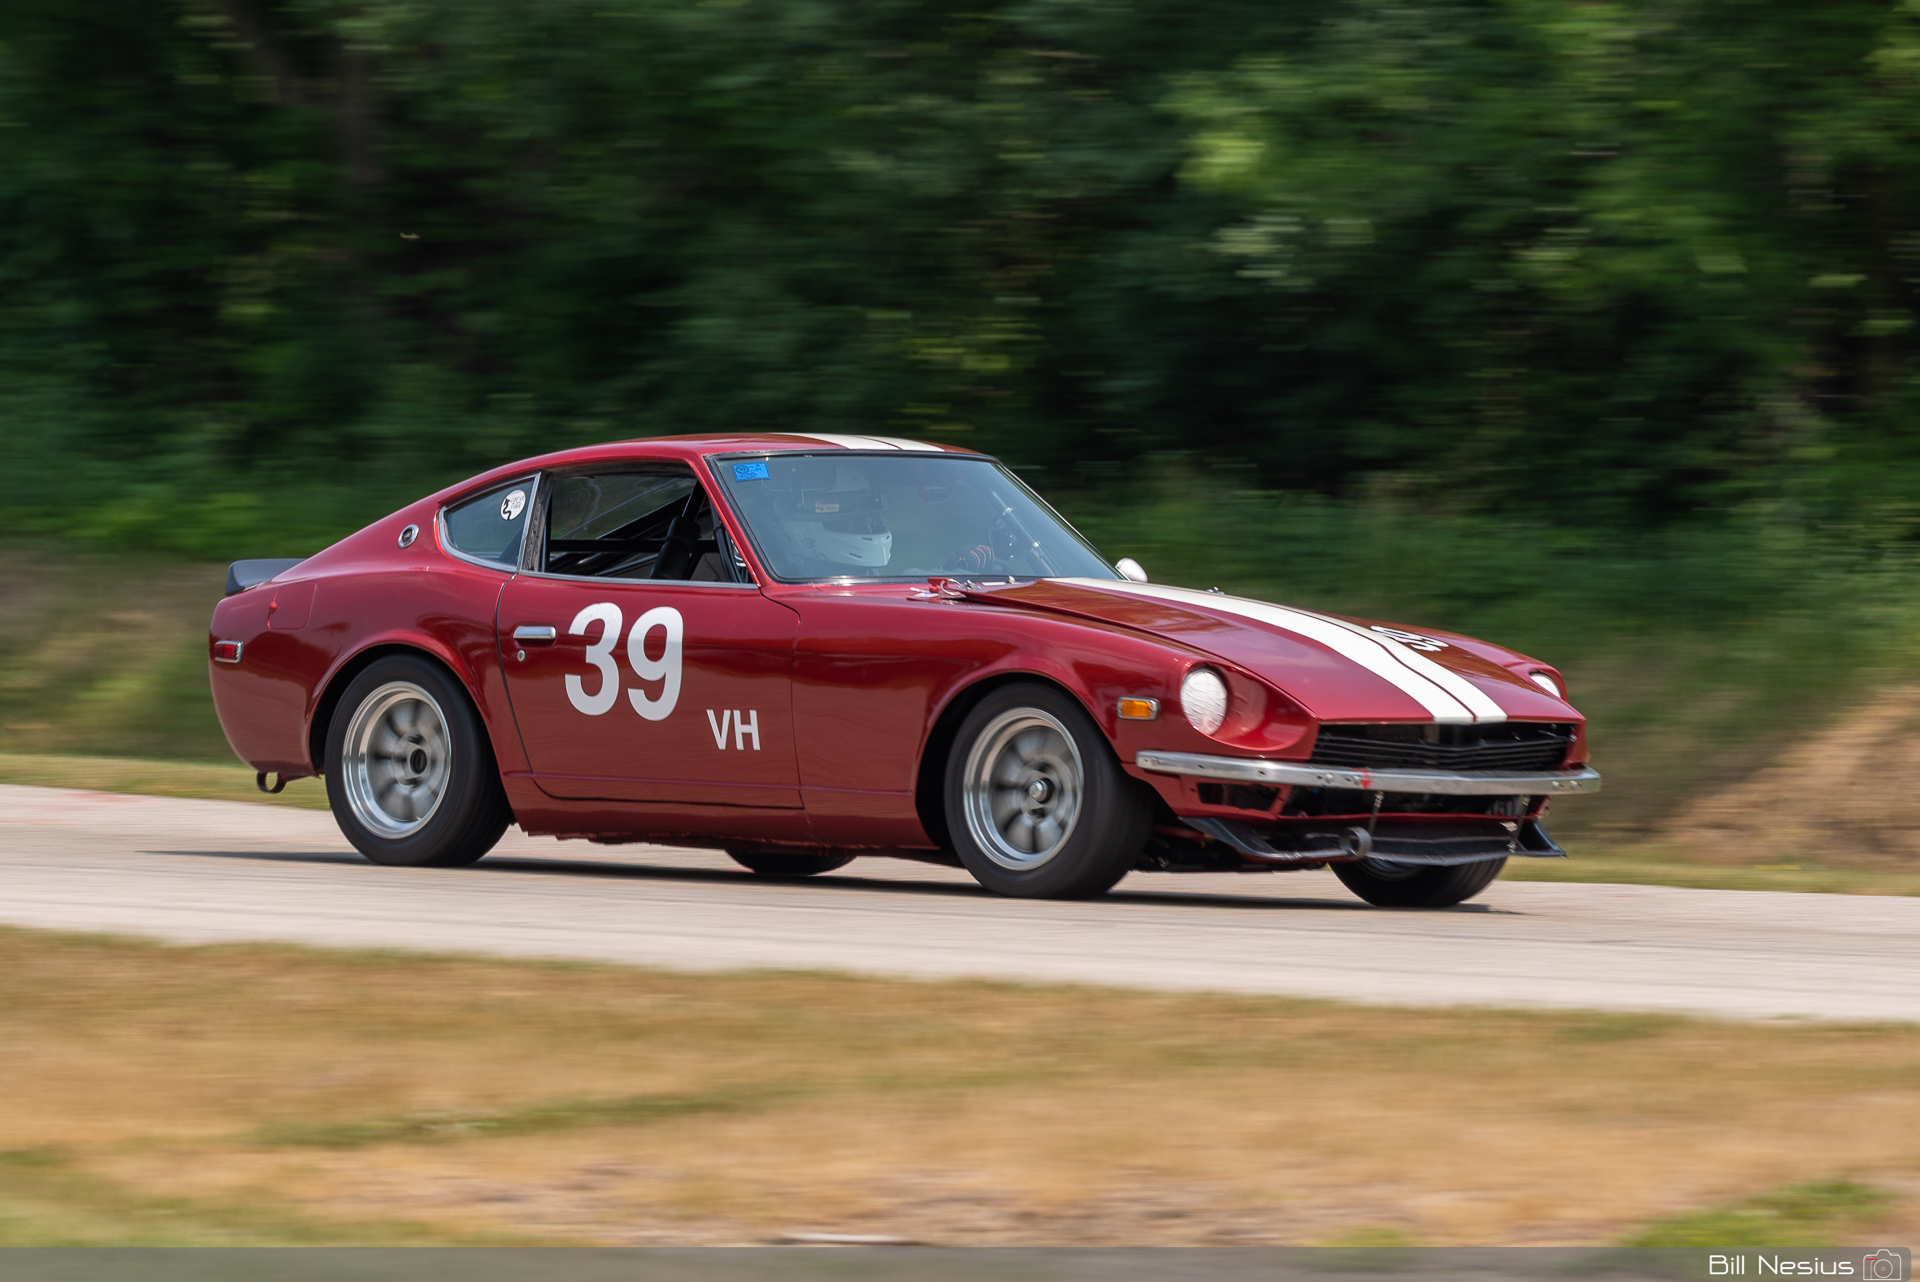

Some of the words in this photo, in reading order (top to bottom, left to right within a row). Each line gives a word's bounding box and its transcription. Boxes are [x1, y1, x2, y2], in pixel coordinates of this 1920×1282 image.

[1370, 625, 1449, 652] 39
[564, 602, 684, 721] 39
[706, 709, 761, 750] VH
